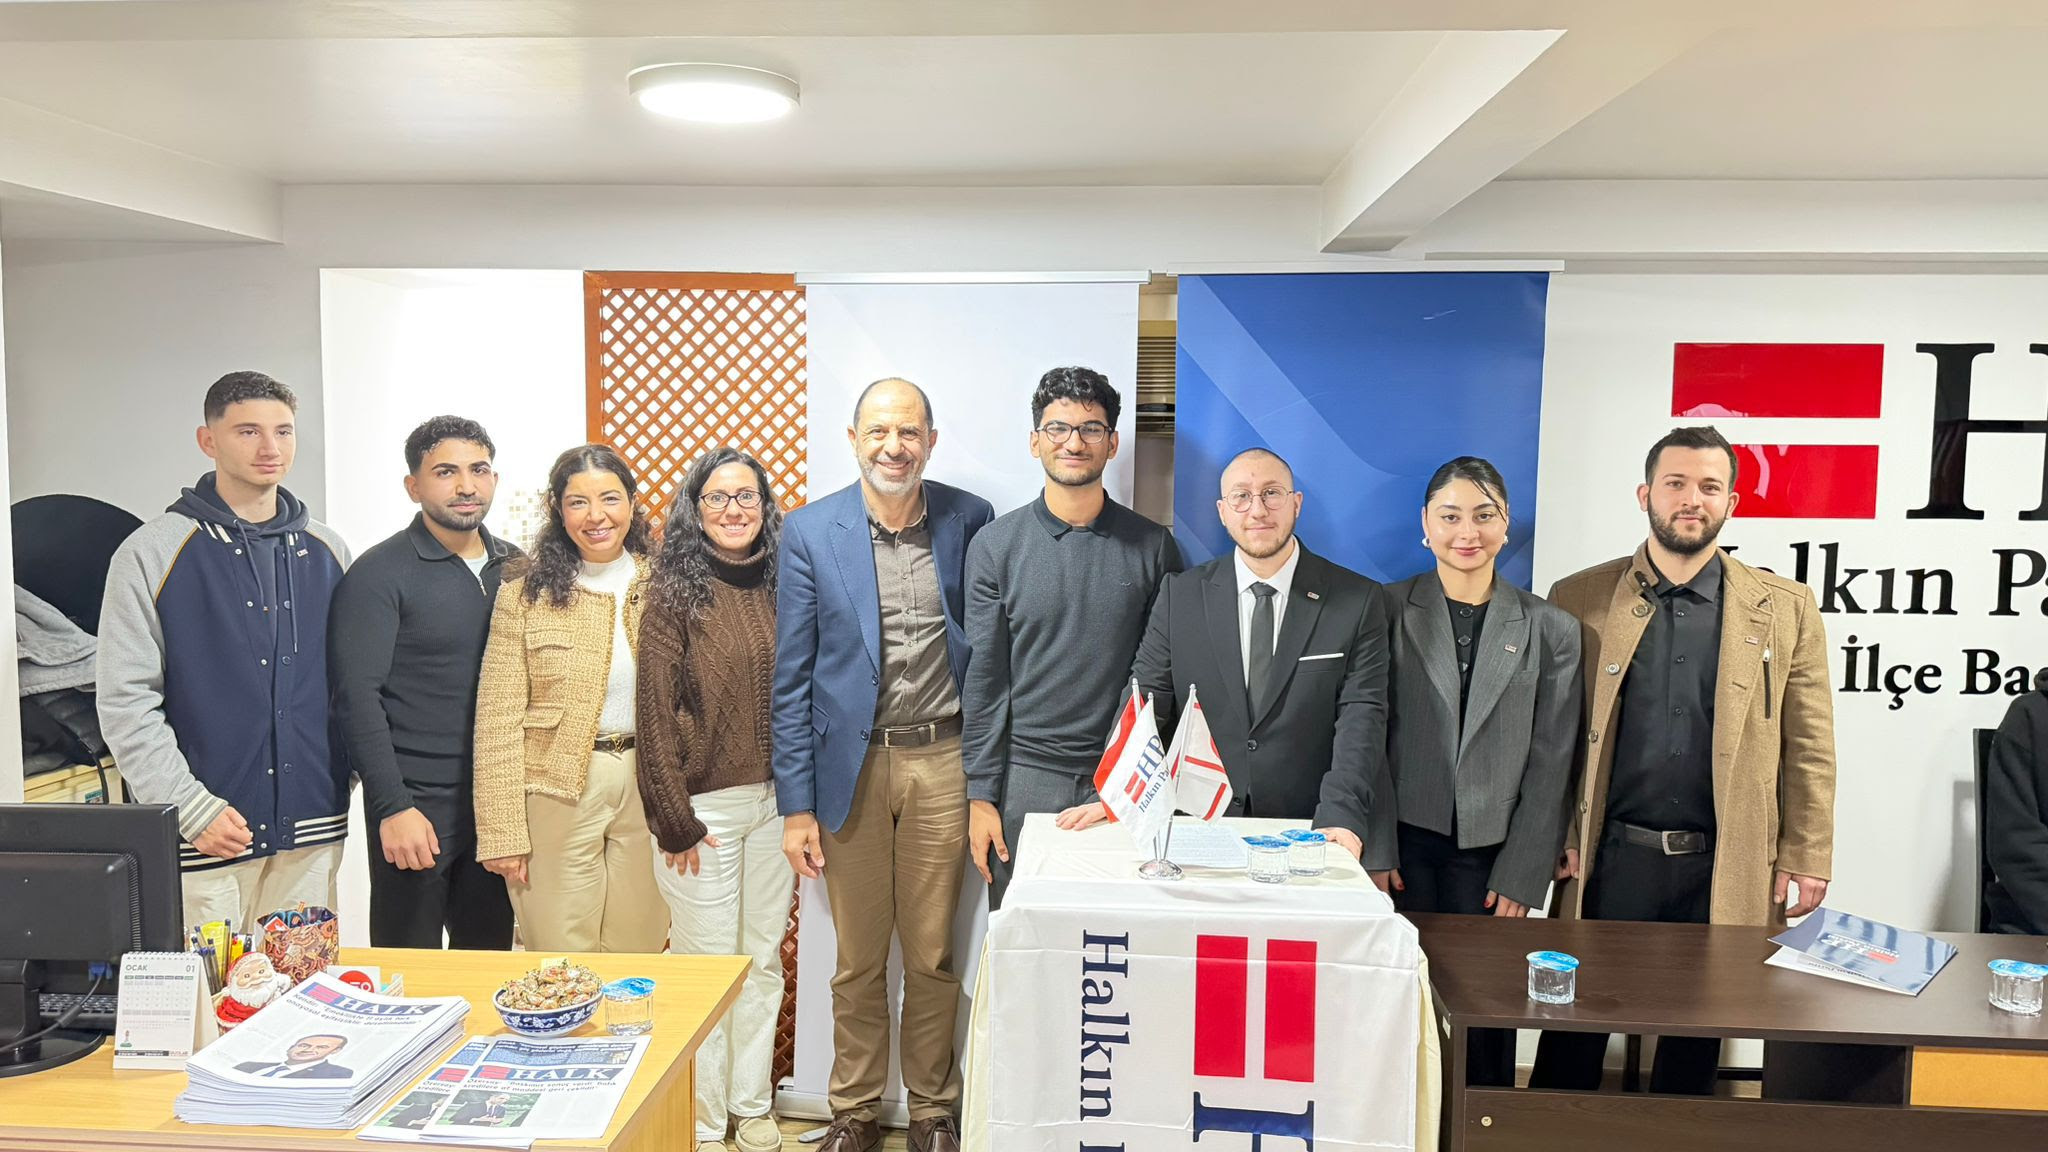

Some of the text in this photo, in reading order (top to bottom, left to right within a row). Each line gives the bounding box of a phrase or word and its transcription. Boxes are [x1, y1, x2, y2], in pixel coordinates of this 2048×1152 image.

[1989, 548, 2048, 616] P
[1839, 635, 1942, 710] İlçe
[1136, 734, 1166, 782] HP
[1138, 781, 1161, 813] Halkın
[126, 964, 196, 973] OCAK 01
[338, 996, 427, 1015] HALK
[1079, 929, 1130, 1121] Halkın
[511, 1067, 613, 1080] HALK
